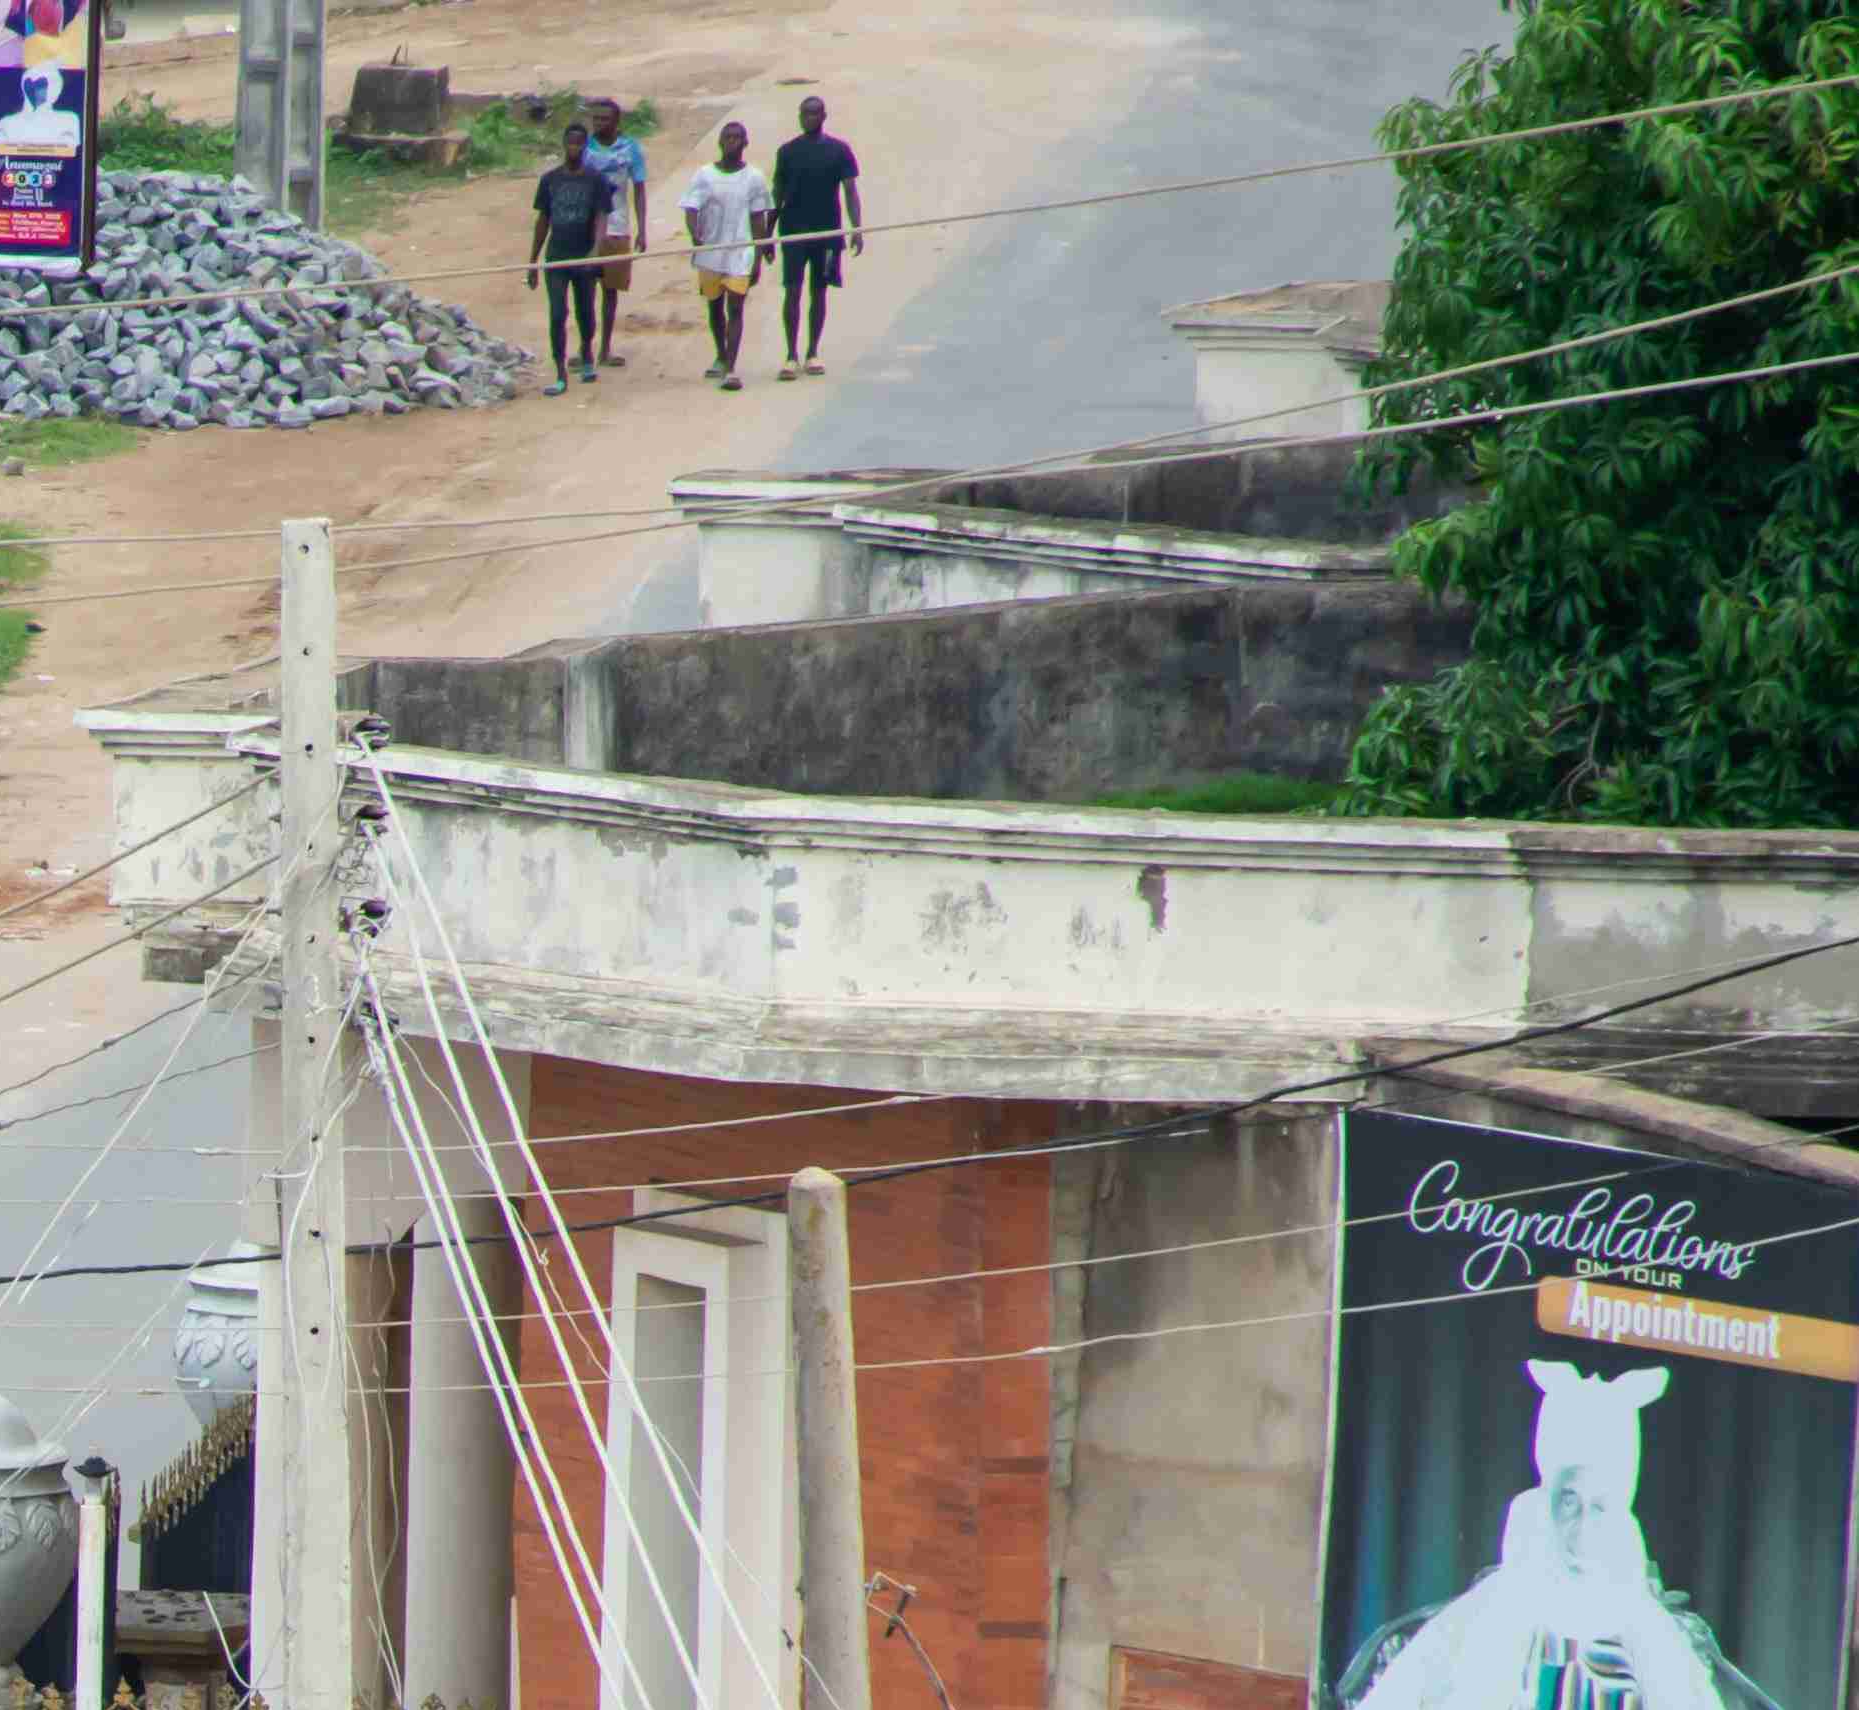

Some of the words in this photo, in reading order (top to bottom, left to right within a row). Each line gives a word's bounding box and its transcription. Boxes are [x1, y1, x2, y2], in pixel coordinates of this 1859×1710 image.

[1409, 1160, 1756, 1290] Congratulations
[1576, 1258, 1609, 1277] ON
[1621, 1266, 1683, 1289] YOUR
[1568, 1281, 1781, 1359] Appointment
